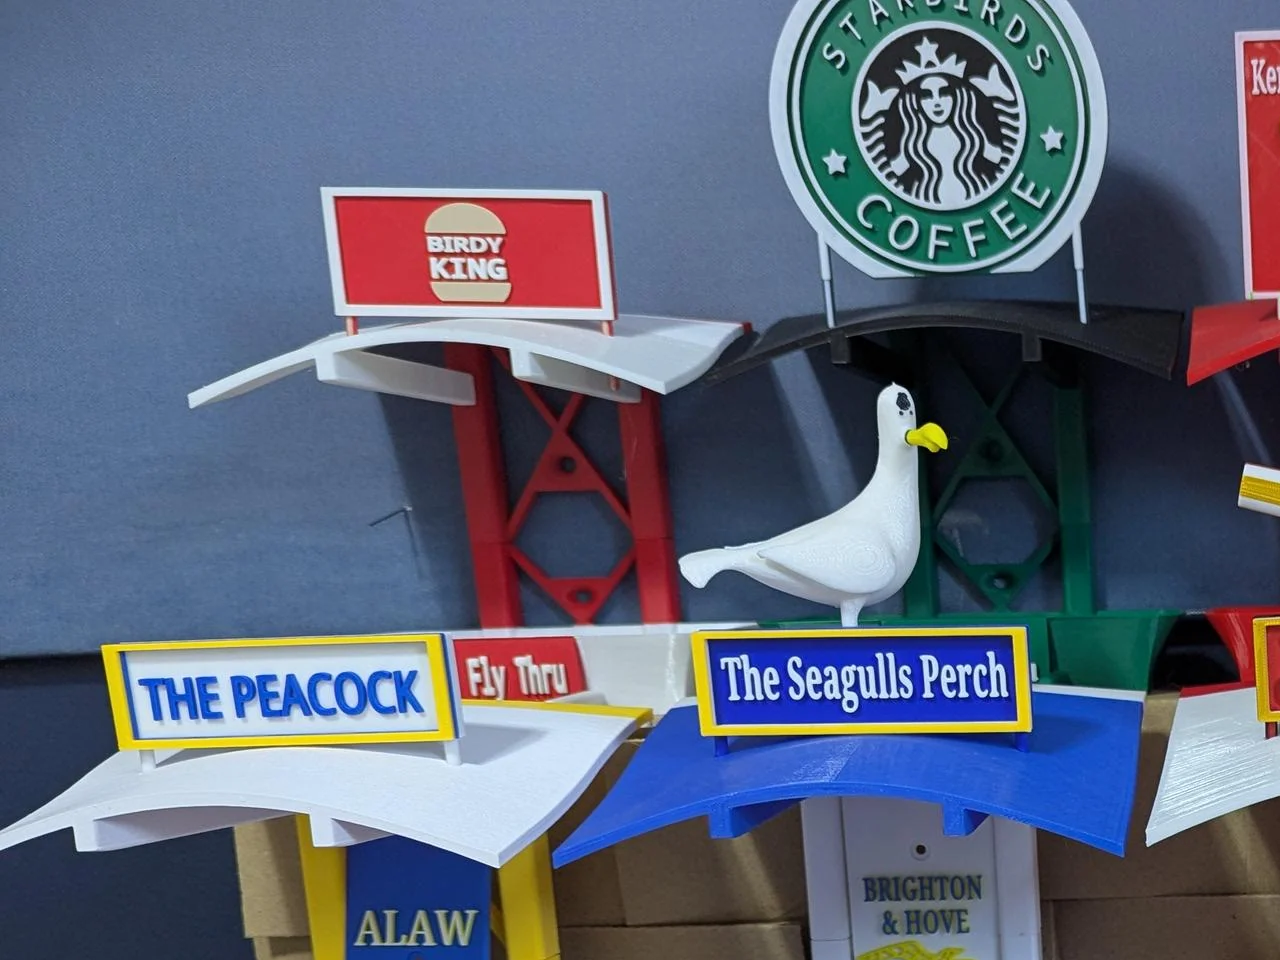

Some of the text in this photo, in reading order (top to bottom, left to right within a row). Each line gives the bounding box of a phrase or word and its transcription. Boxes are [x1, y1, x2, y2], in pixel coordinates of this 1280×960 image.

[856, 172, 1051, 260] COFFEE
[426, 236, 503, 254] BIRDY
[429, 257, 508, 280] KING
[466, 654, 568, 700] Fly Thru
[720, 651, 1009, 713] The Seagulls Perch
[138, 670, 426, 721] THE PEACOCK
[862, 875, 983, 902] BRIGHTON
[353, 910, 480, 946] ALAW
[881, 909, 971, 935] & HOVE
